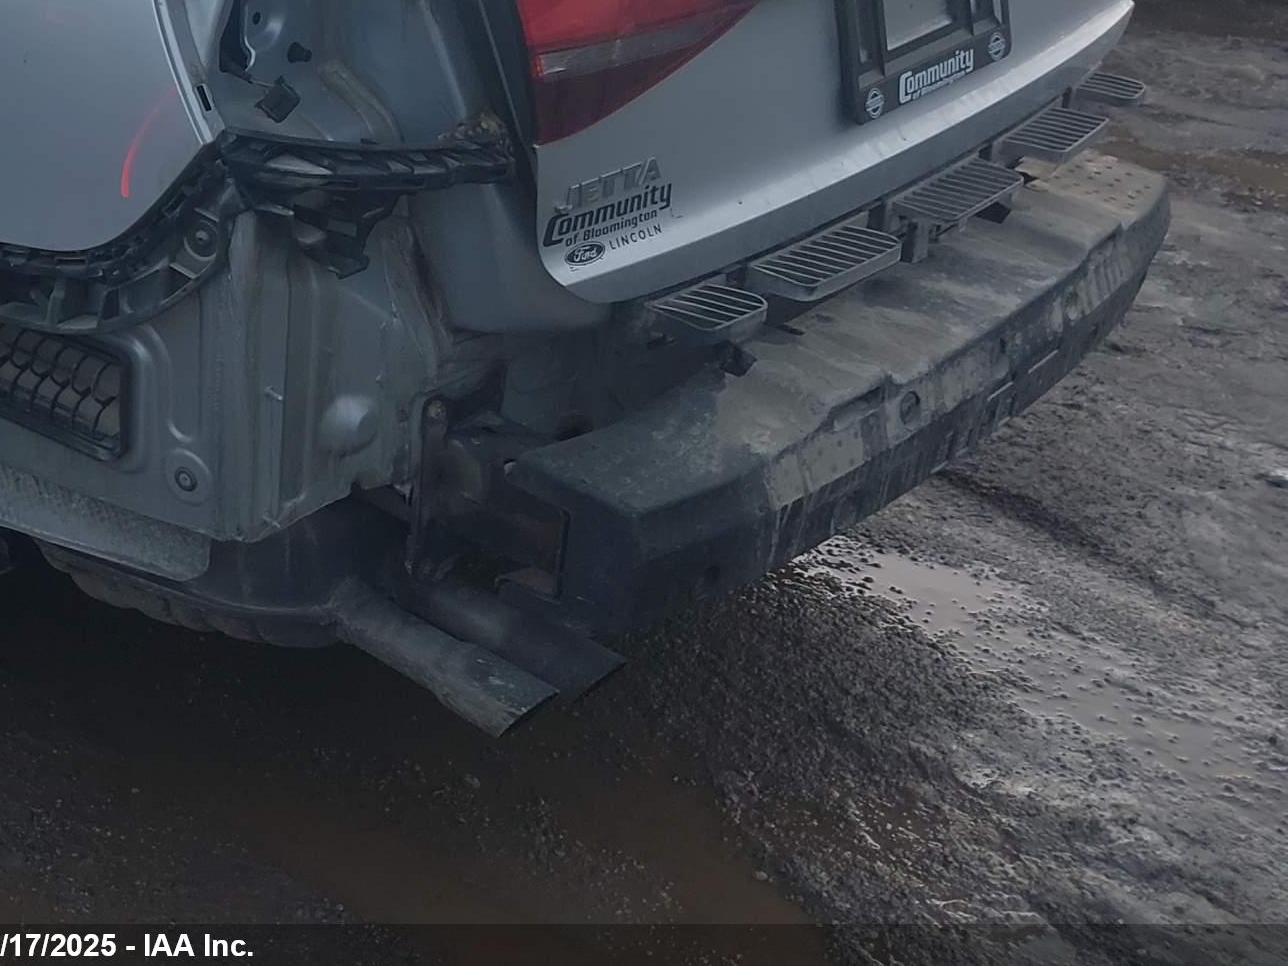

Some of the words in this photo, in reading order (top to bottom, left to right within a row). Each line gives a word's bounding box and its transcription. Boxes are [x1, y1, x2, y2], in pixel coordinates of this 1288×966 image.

[899, 49, 974, 104] Community
[554, 157, 661, 213] JETTA
[543, 183, 673, 248] Community
[565, 232, 580, 247] of
[583, 209, 658, 241] Bloomington
[608, 223, 663, 250] LINCOLN
